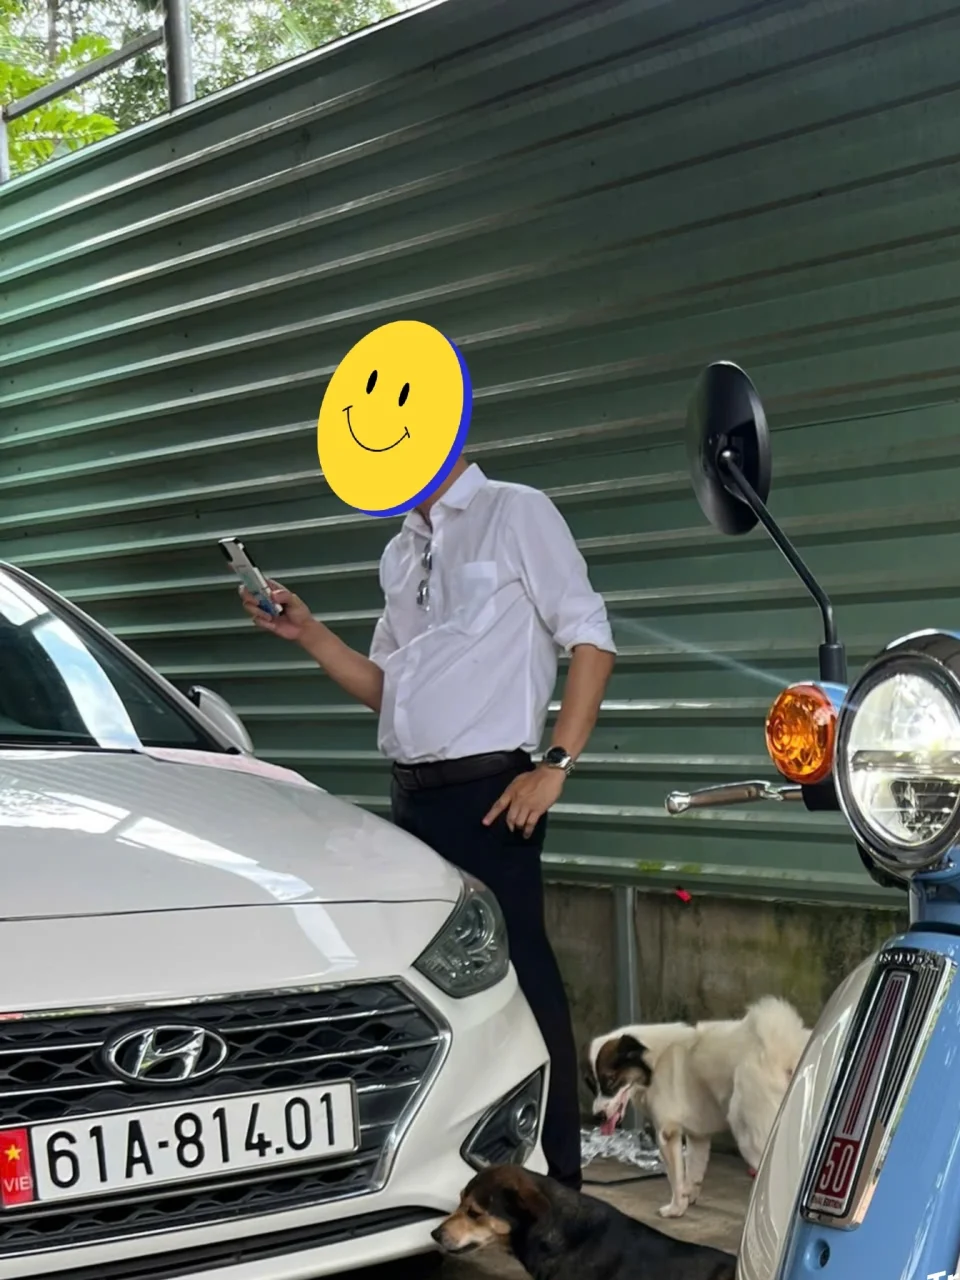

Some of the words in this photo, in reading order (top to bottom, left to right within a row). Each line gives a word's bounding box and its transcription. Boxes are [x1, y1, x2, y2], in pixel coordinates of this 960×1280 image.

[45, 1091, 337, 1189] 61A-814.01
[4, 1176, 32, 1192] VIE
[819, 1141, 854, 1193] 50
